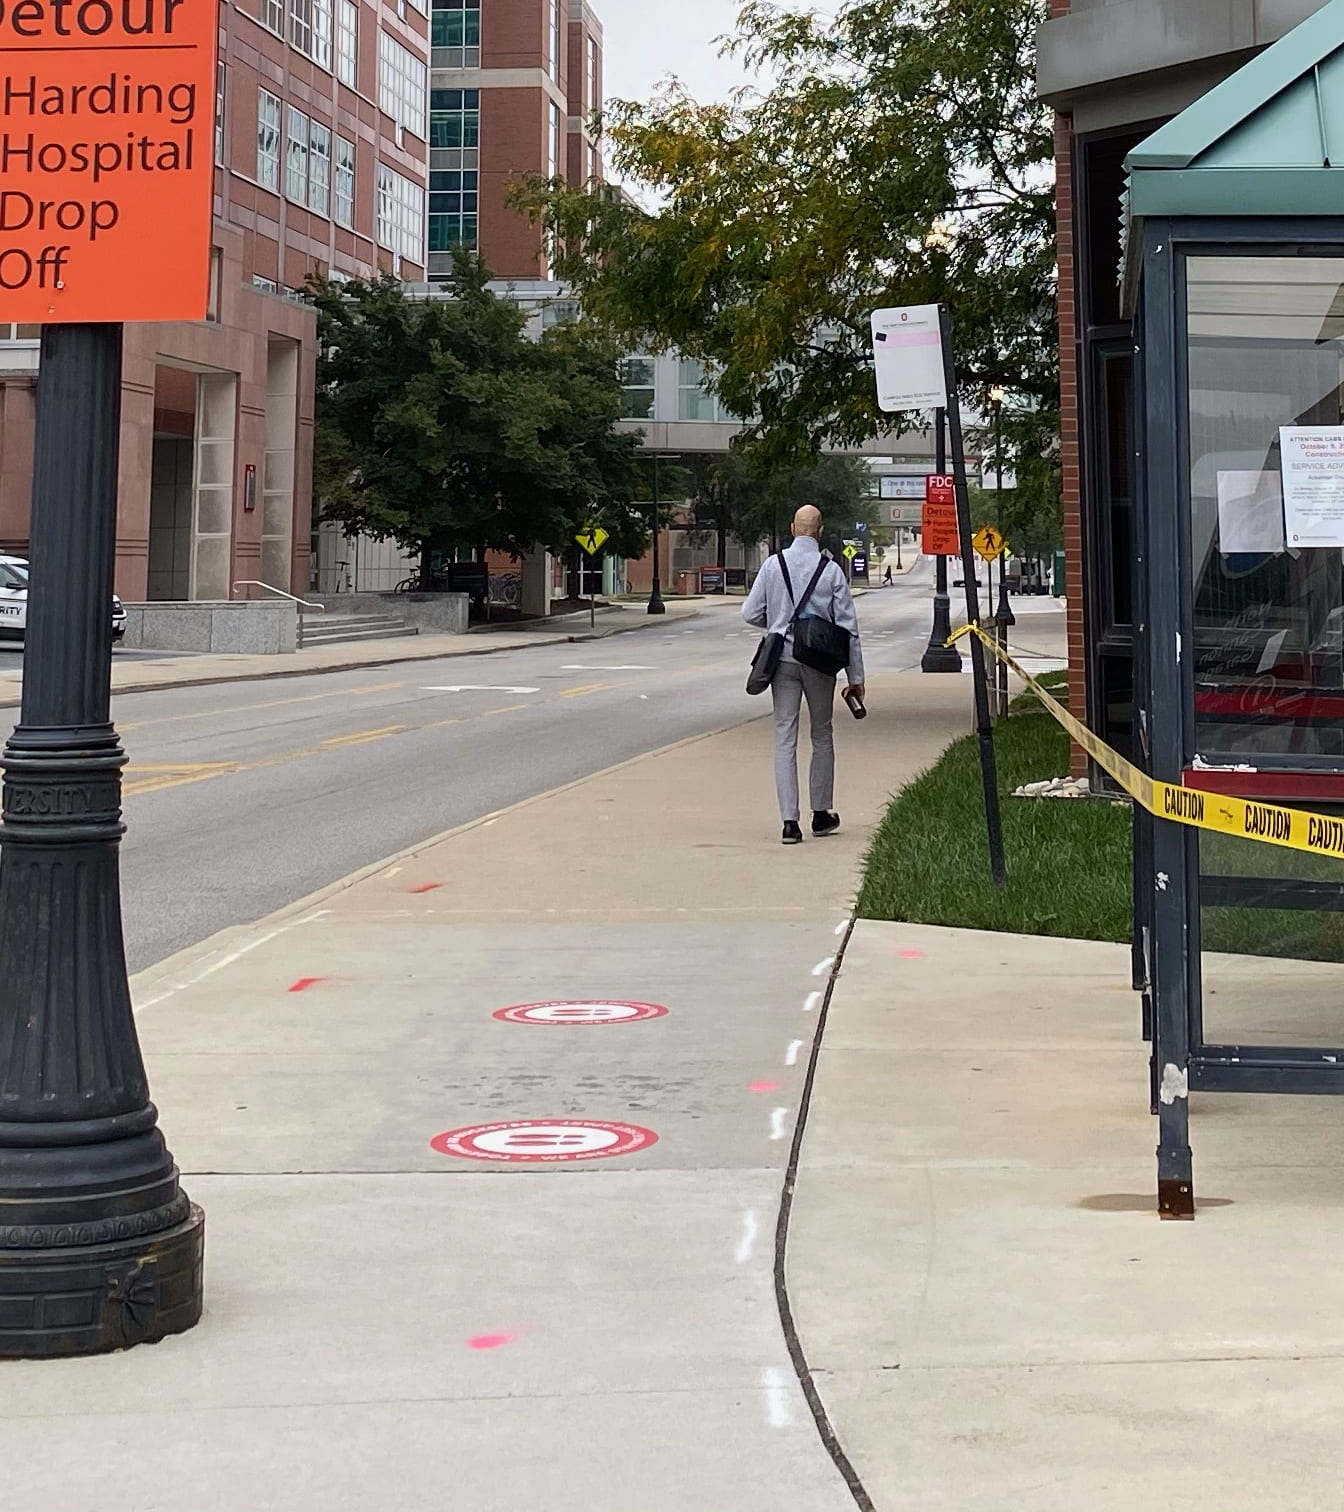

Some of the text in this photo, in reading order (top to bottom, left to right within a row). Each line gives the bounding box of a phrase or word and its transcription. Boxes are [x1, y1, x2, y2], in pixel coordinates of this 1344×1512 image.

[3, 72, 197, 124] Harding
[1, 128, 194, 183] Hospital
[0, 190, 119, 241] Drop
[928, 475, 954, 488] FDC
[1291, 462, 1325, 470] SERVICE
[1164, 787, 1204, 822] CAUTION
[1245, 805, 1291, 841] CAUTION
